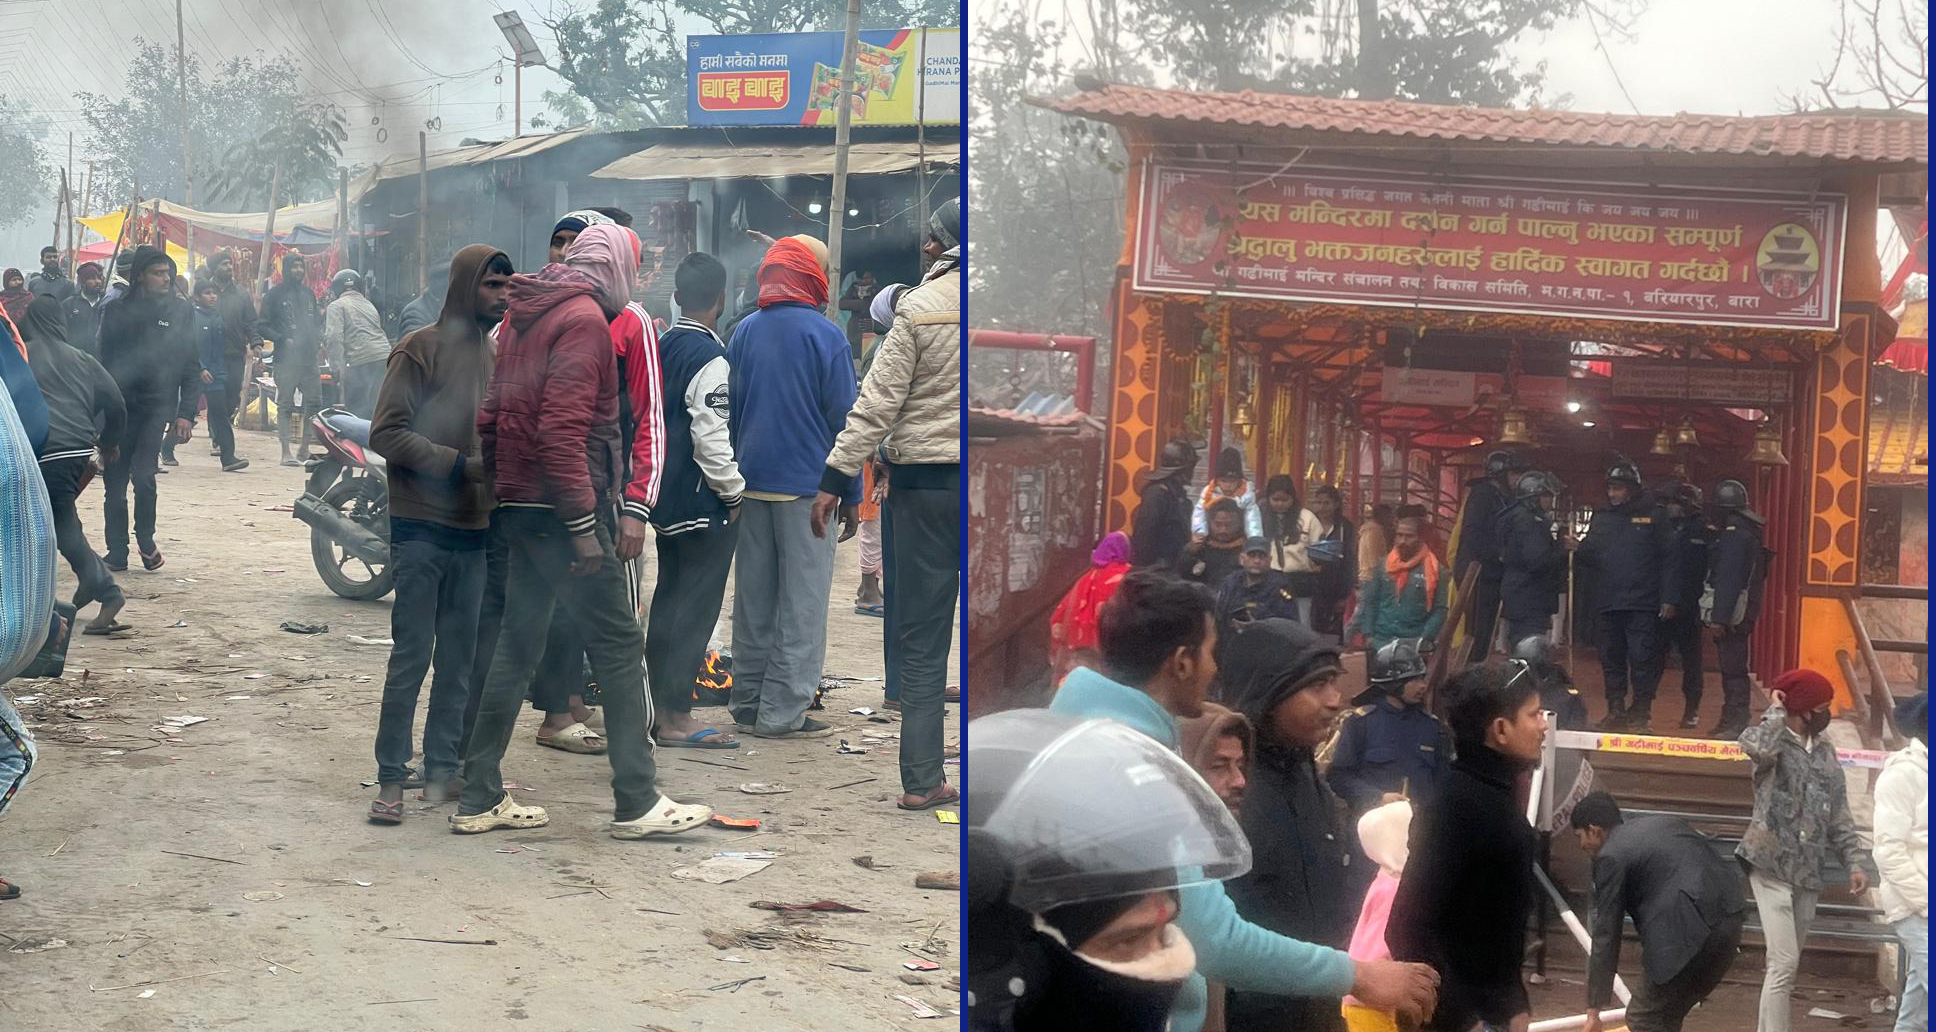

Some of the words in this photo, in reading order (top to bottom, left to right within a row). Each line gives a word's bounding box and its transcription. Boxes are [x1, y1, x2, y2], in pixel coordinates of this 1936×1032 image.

[699, 53, 723, 70] हामी
[759, 54, 788, 67] मनमा
[926, 56, 960, 65] CHAND
[1288, 199, 1394, 229] मन्दिरमा
[1468, 212, 1511, 236] गर्न
[1587, 221, 1657, 244] भएका
[1664, 224, 1744, 252] सम्पूर्ण
[1490, 245, 1569, 273] हार्दिक
[1575, 256, 1653, 280] स्वागत
